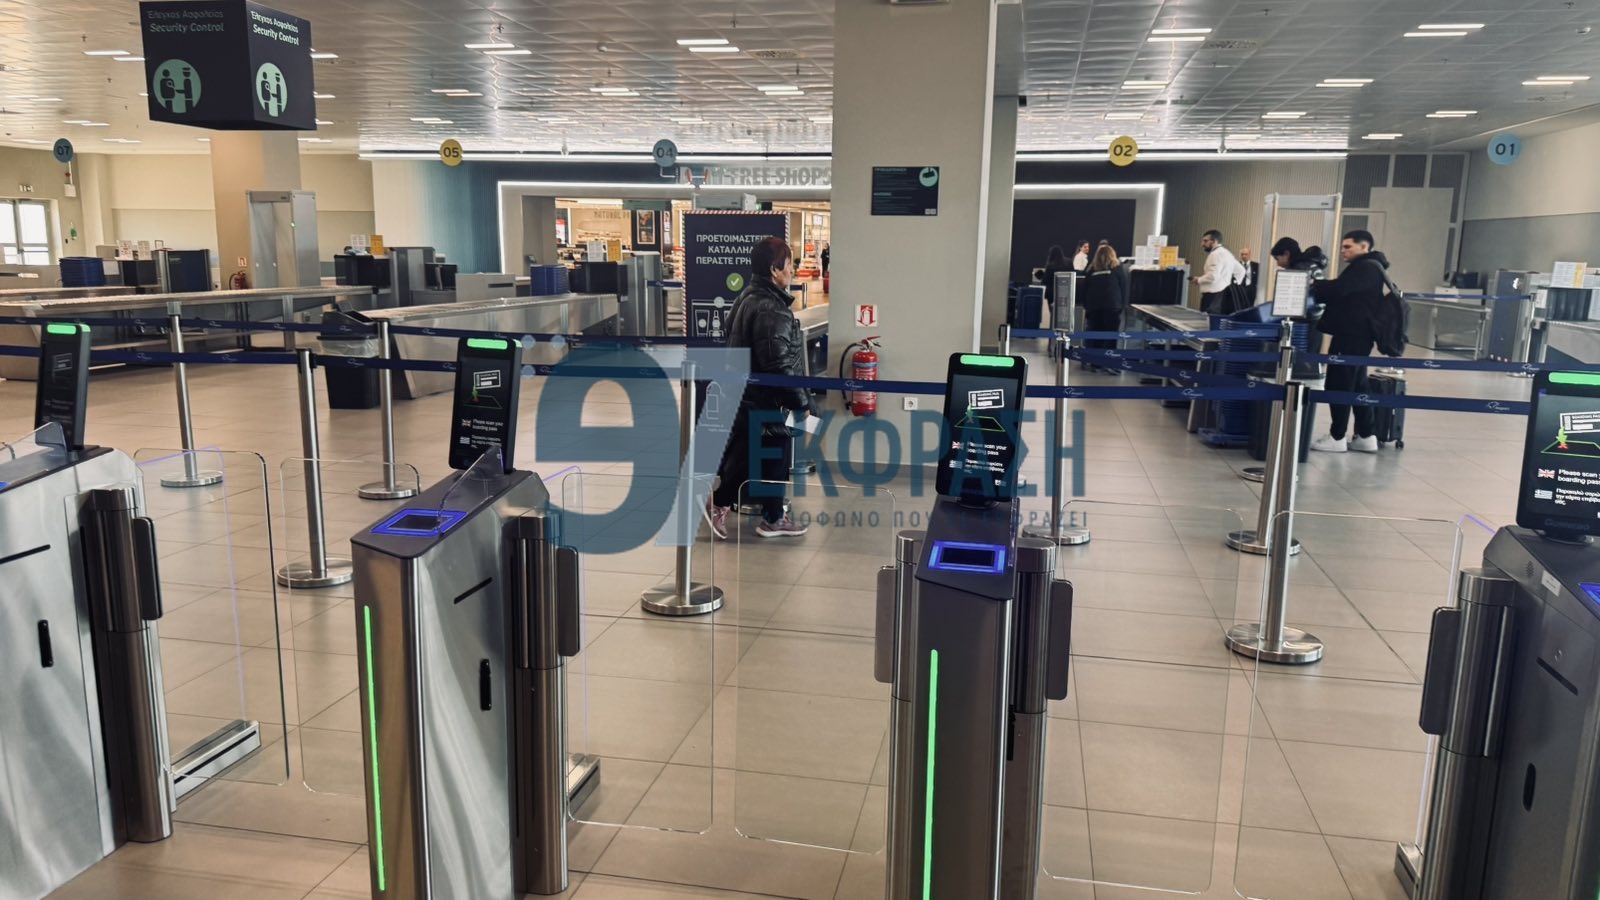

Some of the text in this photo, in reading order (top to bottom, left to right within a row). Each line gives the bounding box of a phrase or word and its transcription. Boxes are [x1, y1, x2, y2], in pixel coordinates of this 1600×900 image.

[150, 22, 225, 34] Security Control
[252, 24, 300, 46] Security Control
[56, 145, 70, 156] 07
[443, 146, 460, 158] 05
[656, 147, 673, 158] 04
[1113, 144, 1133, 157] 02
[1495, 143, 1515, 156] 01
[775, 167, 832, 186] SHOPS
[696, 256, 734, 265] ΠΕΡΑΣΤΕ
[1558, 468, 1581, 476] Please
[1557, 475, 1586, 486] boarding
